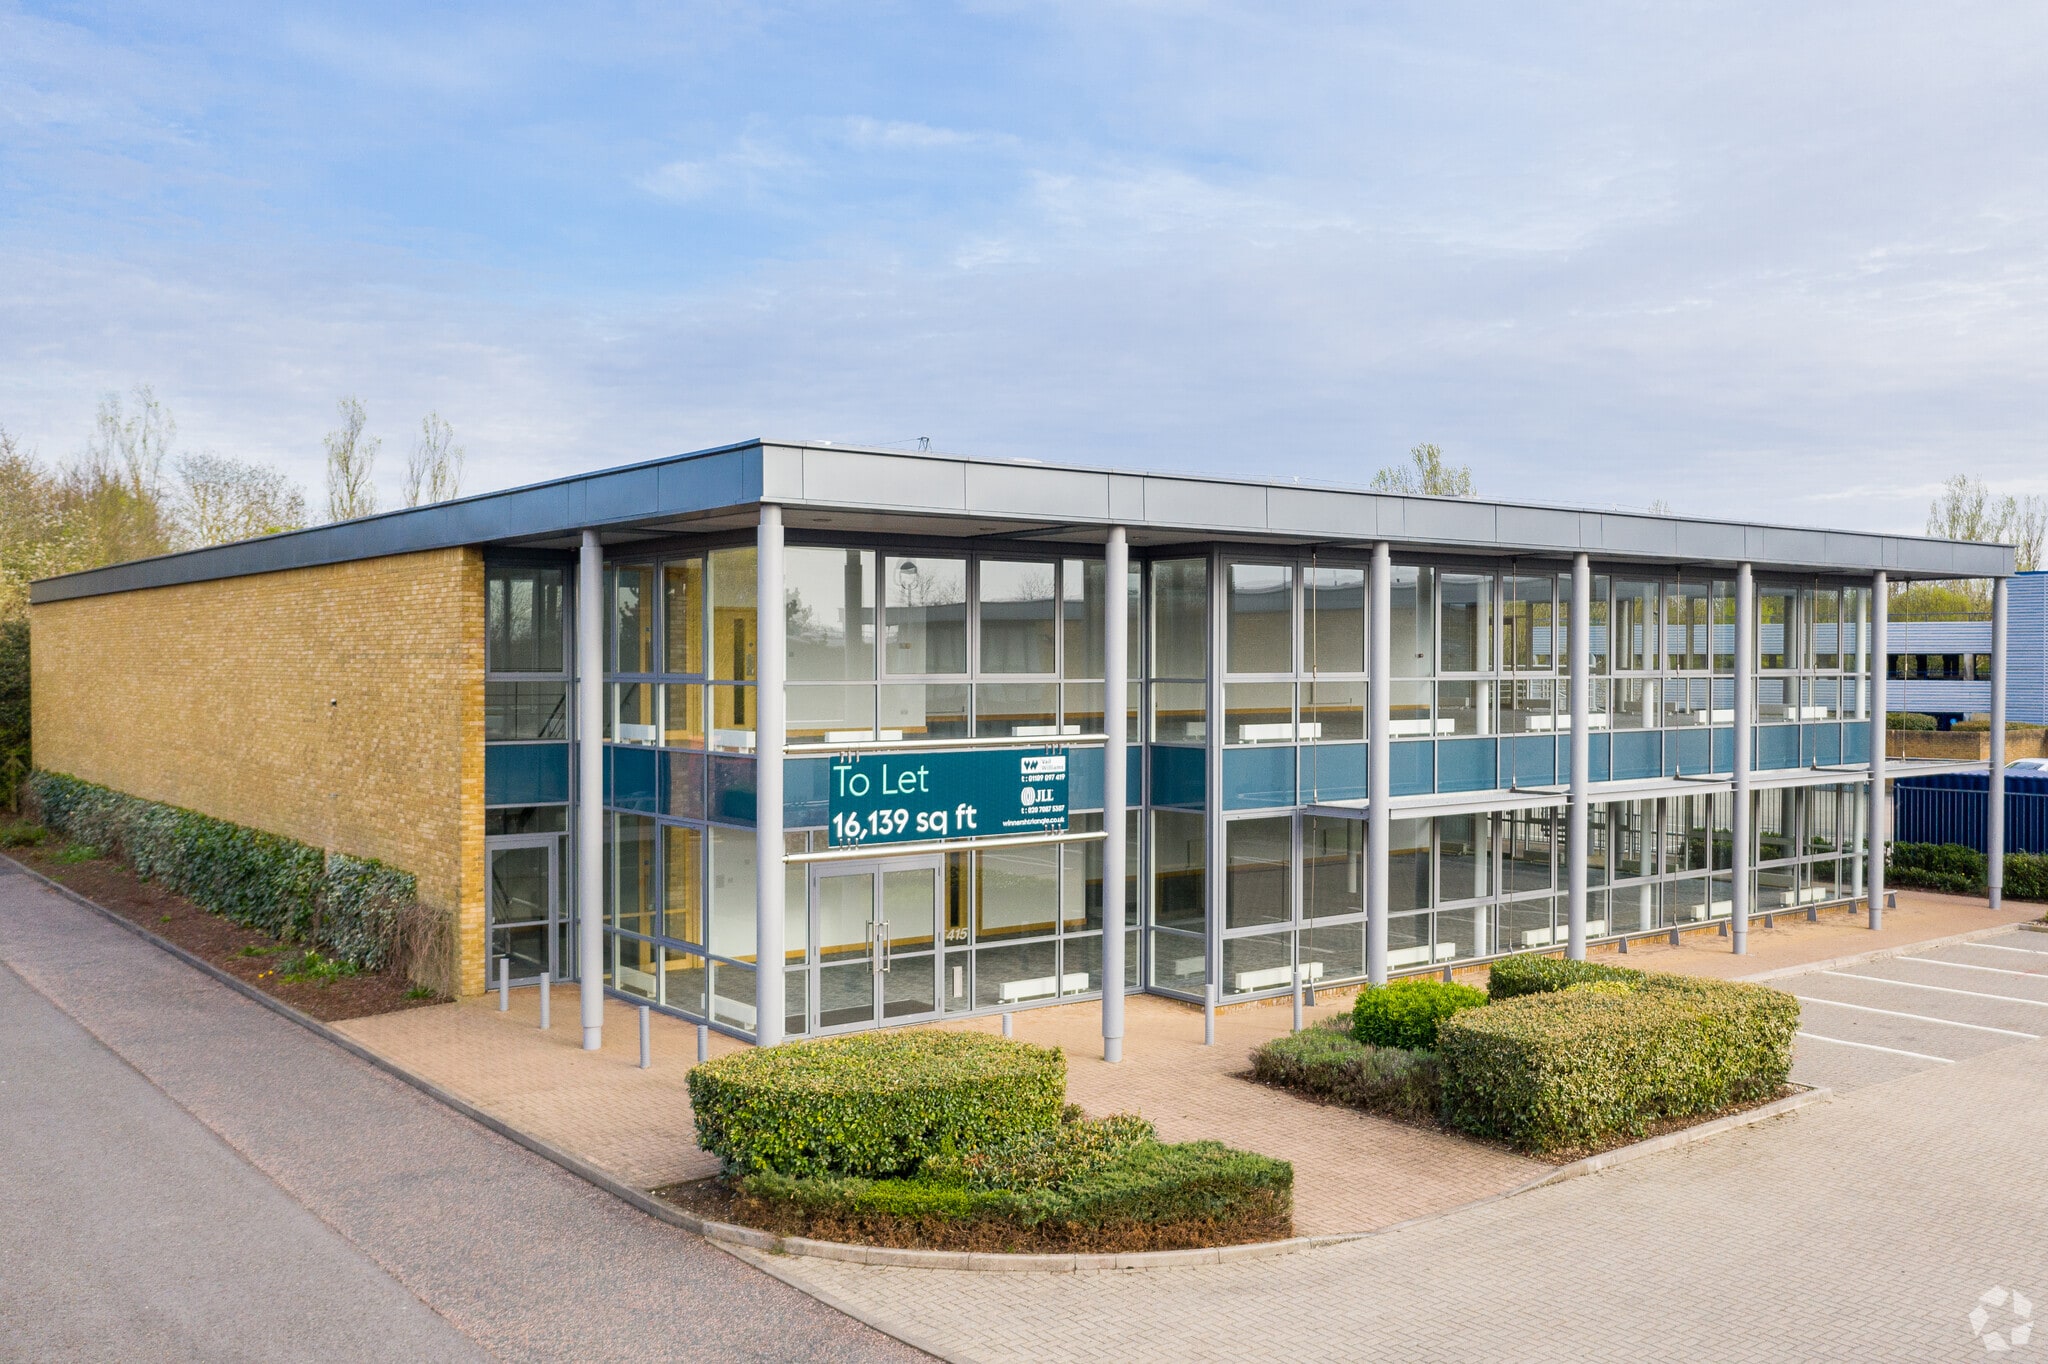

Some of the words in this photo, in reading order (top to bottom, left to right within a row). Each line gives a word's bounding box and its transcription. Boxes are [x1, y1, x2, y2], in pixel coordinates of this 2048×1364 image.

[833, 765, 870, 797] To
[882, 763, 929, 795] Let
[1036, 789, 1054, 803] JLL
[833, 807, 909, 840] 16,139
[916, 809, 948, 835] sq
[956, 803, 977, 830] ft
[1002, 816, 1065, 827] winnershtriangle.co.uk
